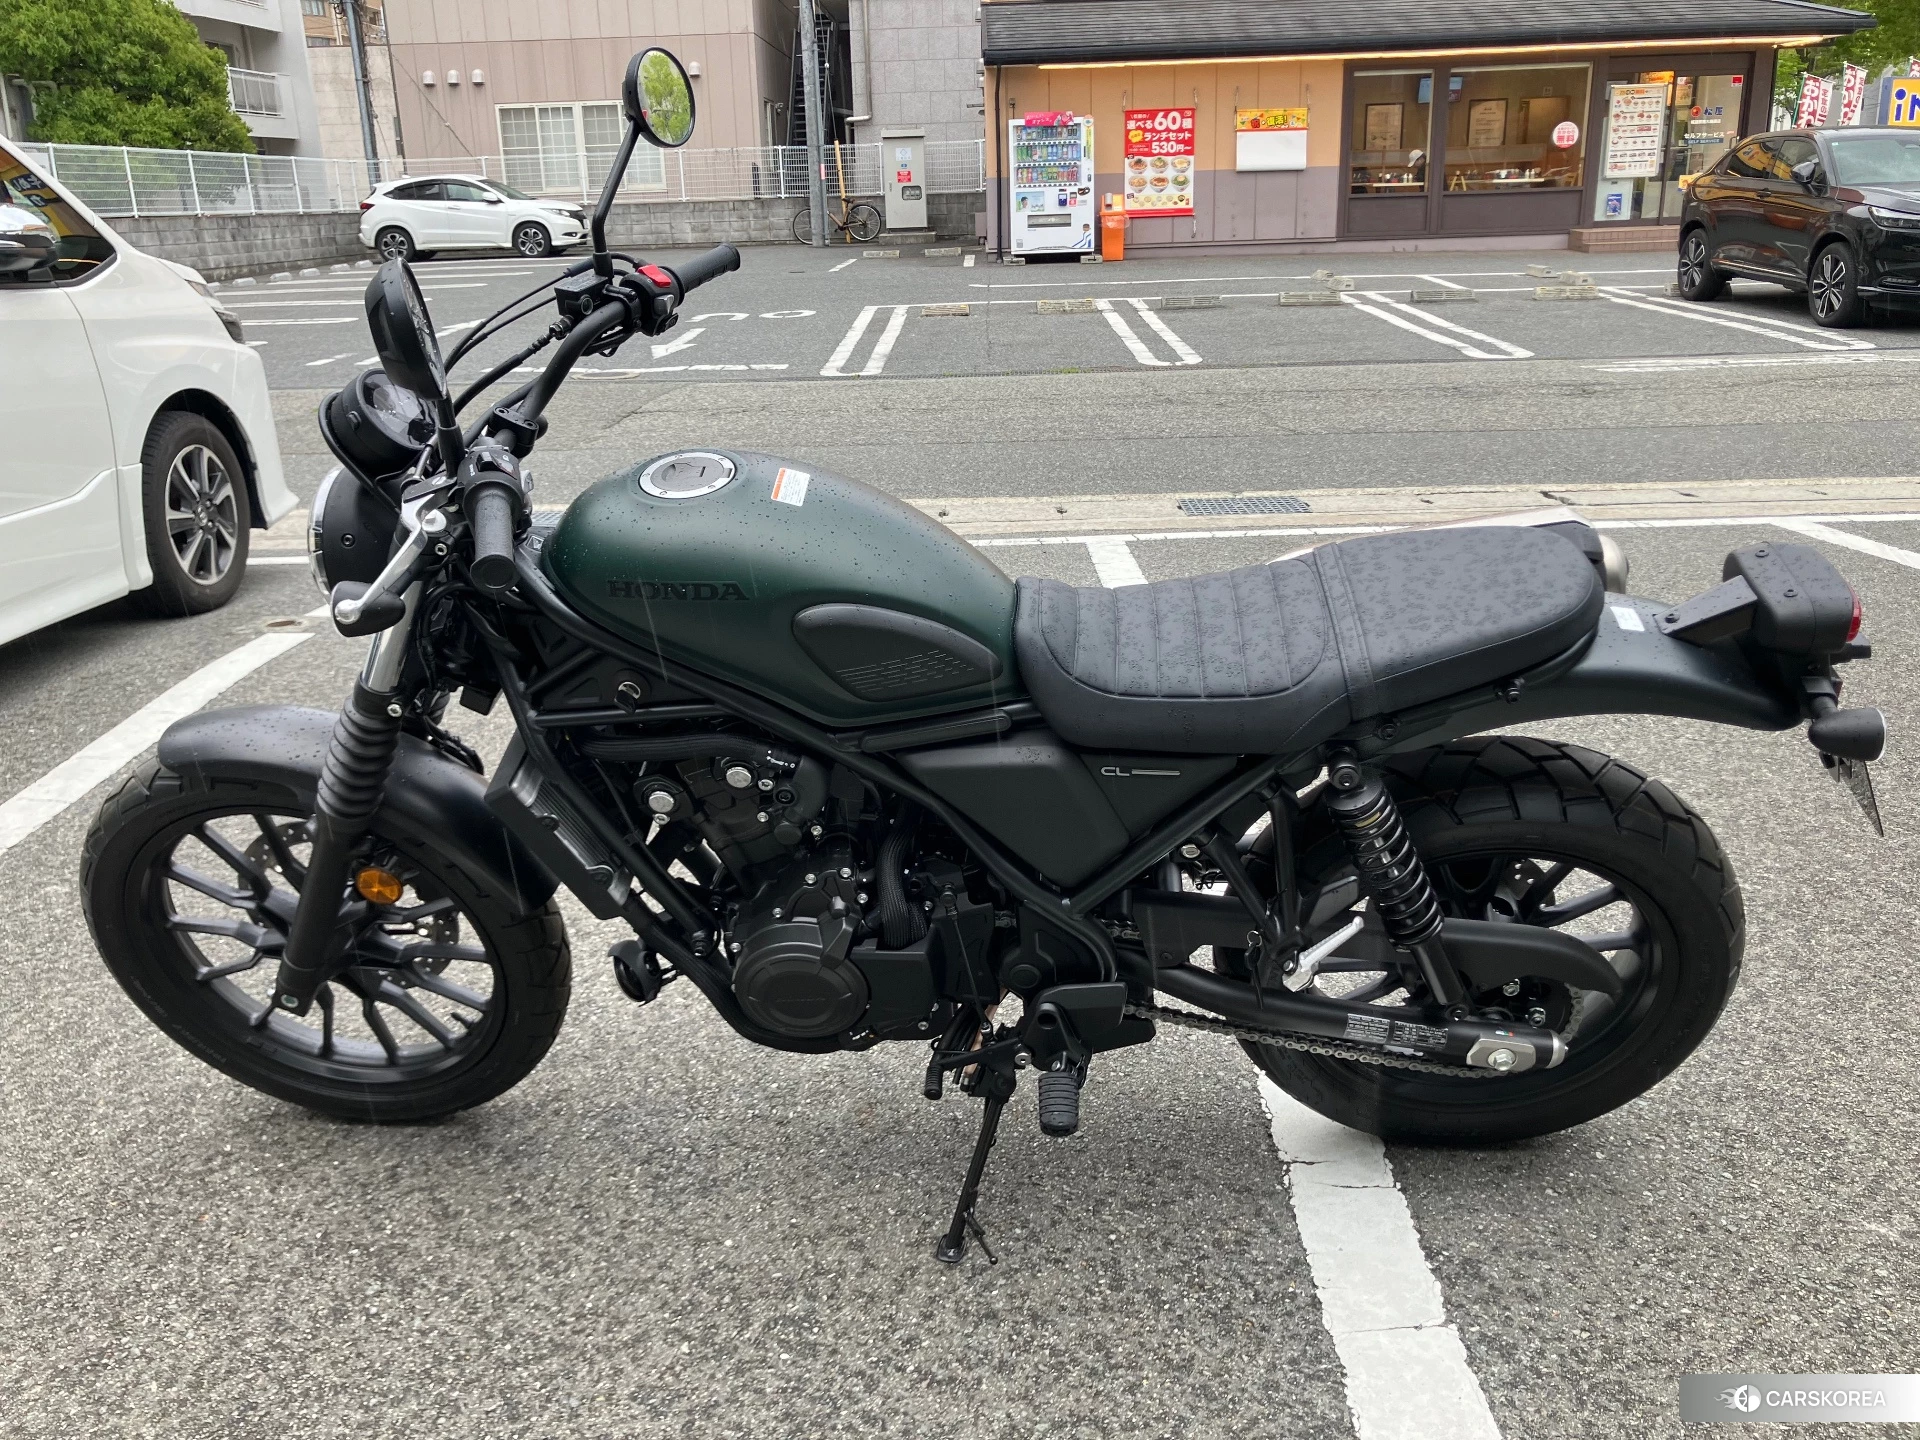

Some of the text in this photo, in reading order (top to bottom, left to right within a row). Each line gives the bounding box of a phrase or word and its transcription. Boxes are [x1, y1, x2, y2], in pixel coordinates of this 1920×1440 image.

[1144, 131, 1192, 141] ランチセット
[1684, 131, 1725, 139] セルフサービス
[607, 580, 749, 600] HONDA
[1101, 767, 1130, 776] CL
